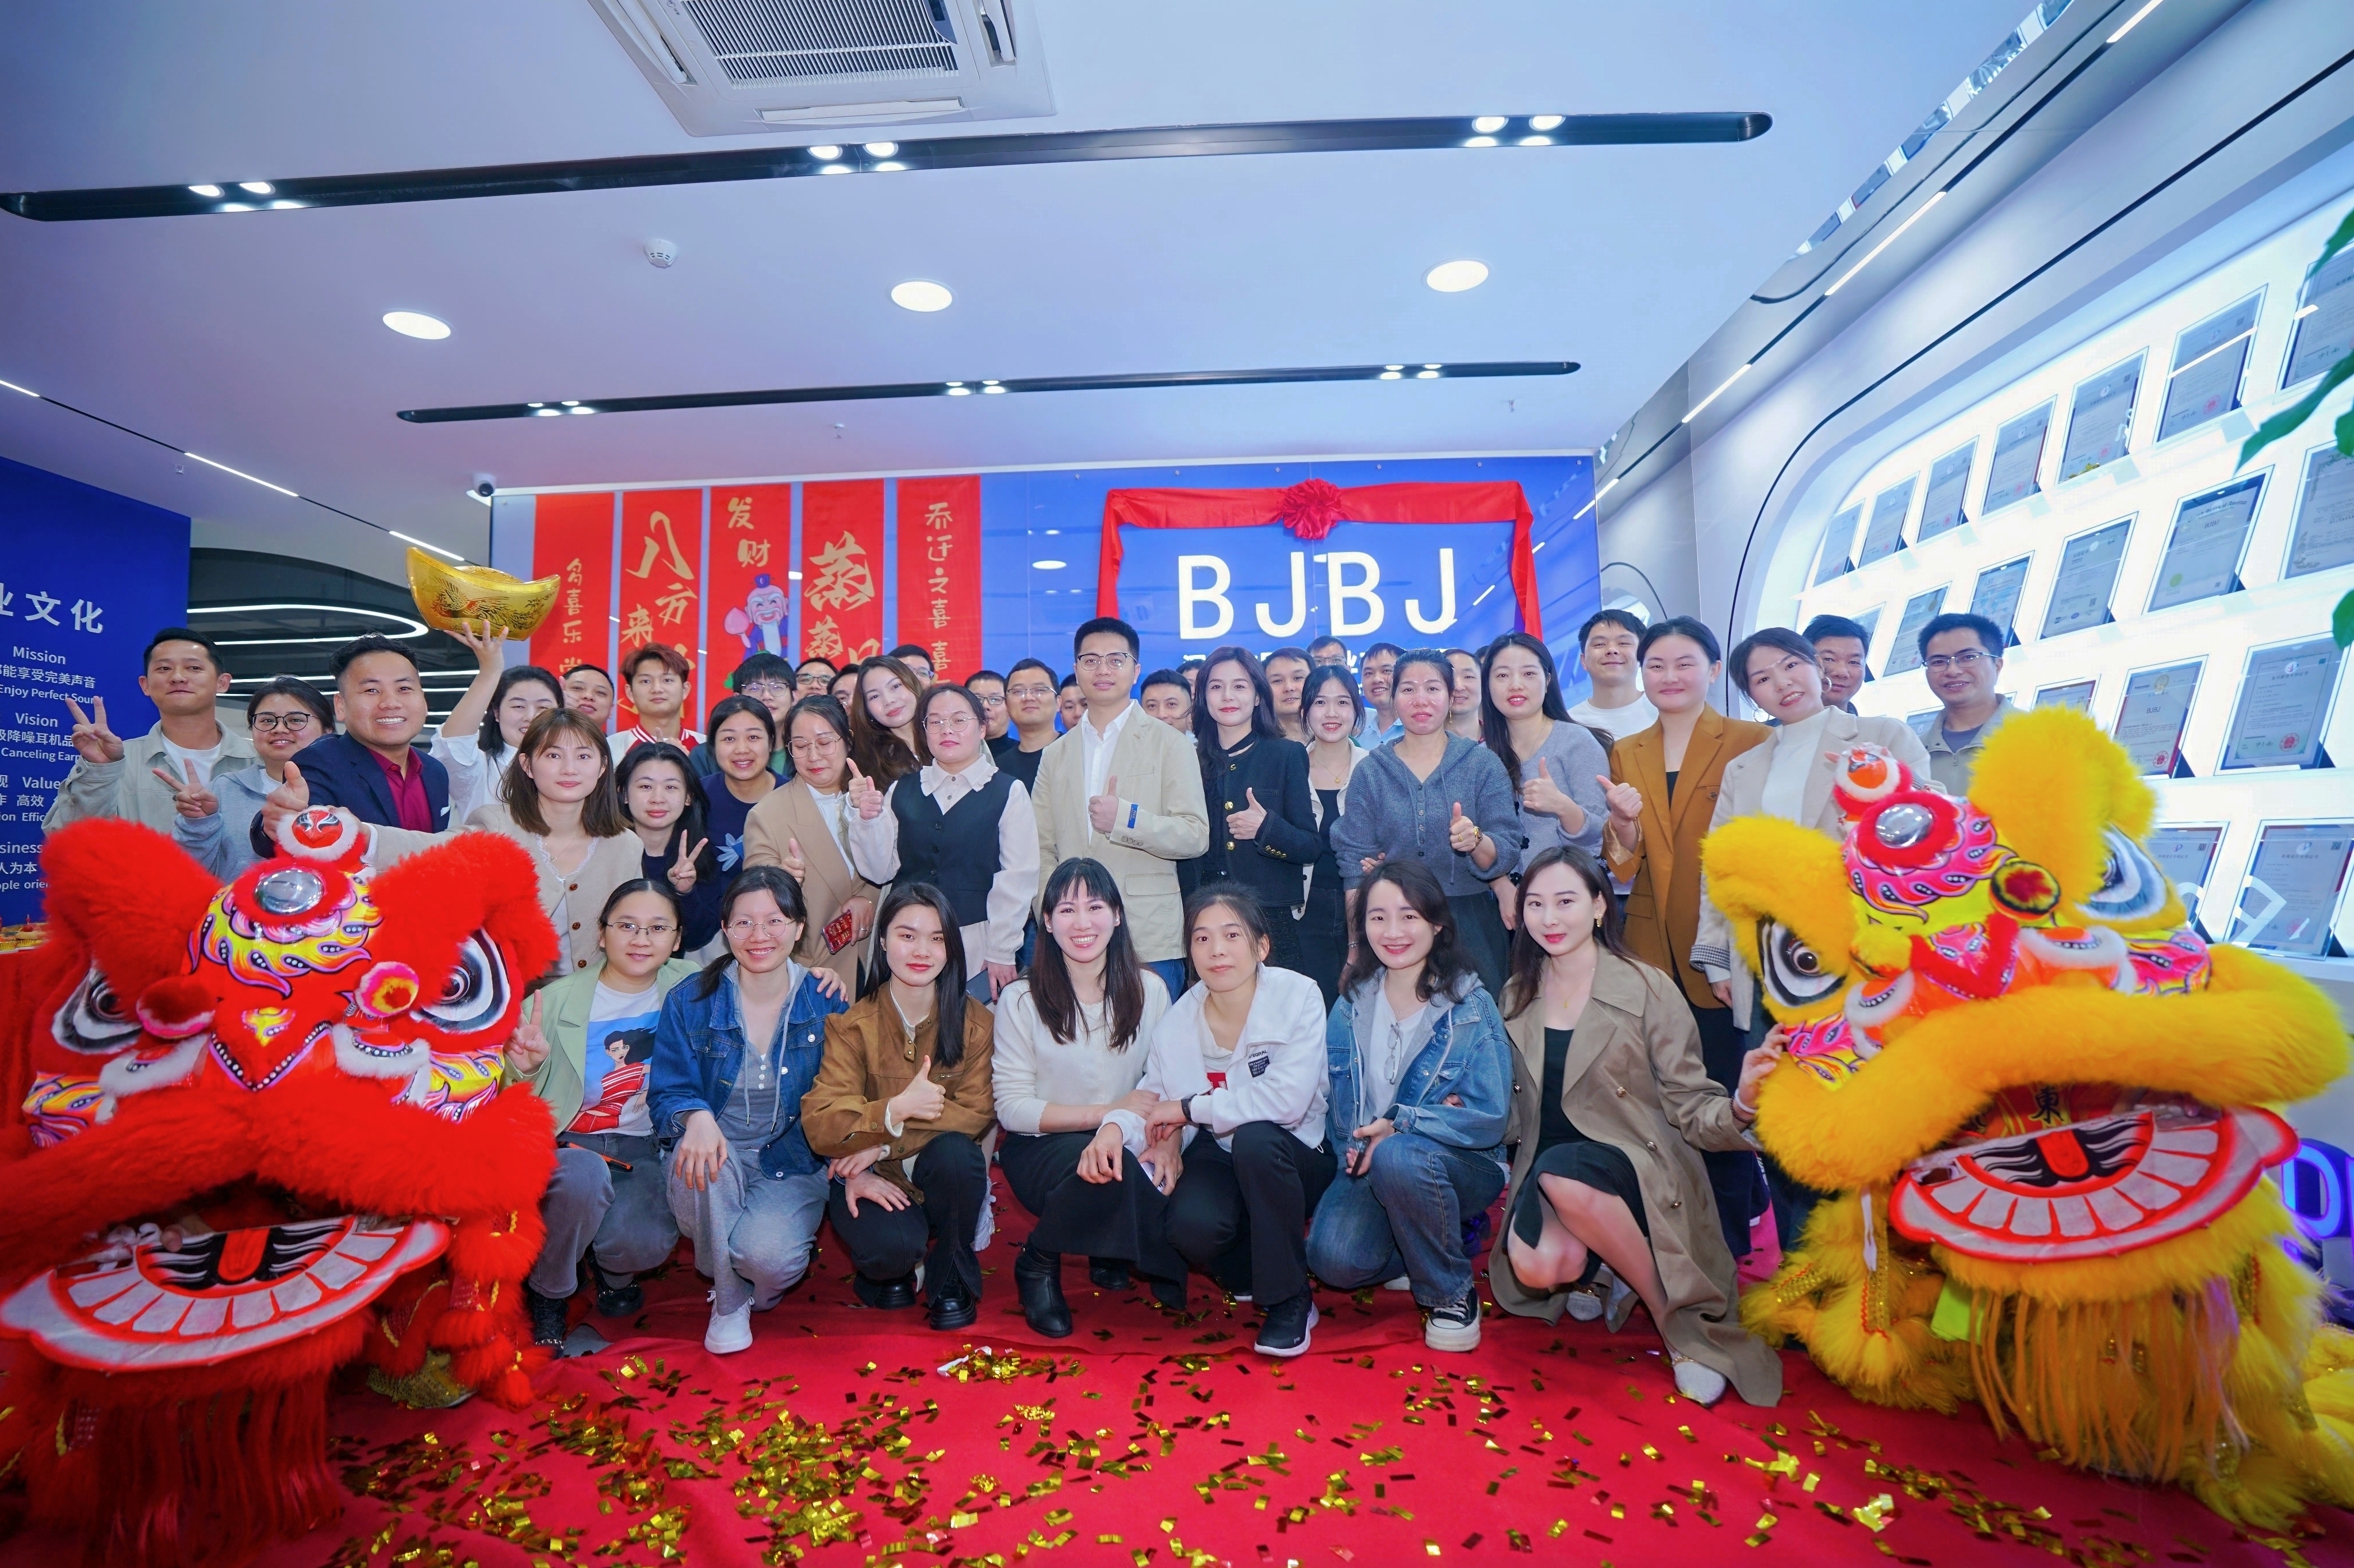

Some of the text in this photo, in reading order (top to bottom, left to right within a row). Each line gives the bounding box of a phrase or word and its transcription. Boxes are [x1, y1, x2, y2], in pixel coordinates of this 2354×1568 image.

[727, 497, 771, 568] 发财
[925, 502, 953, 628] 乔迁之喜
[1178, 548, 1456, 640] BJBJ
[13, 646, 66, 665] Mission
[0, 664, 95, 689] 能享受完美声音
[32, 688, 69, 700] Perfect
[15, 712, 58, 727] Vision
[1, 747, 80, 764] Canceling Earp
[17, 794, 44, 807] 高效
[0, 841, 43, 854] siness
